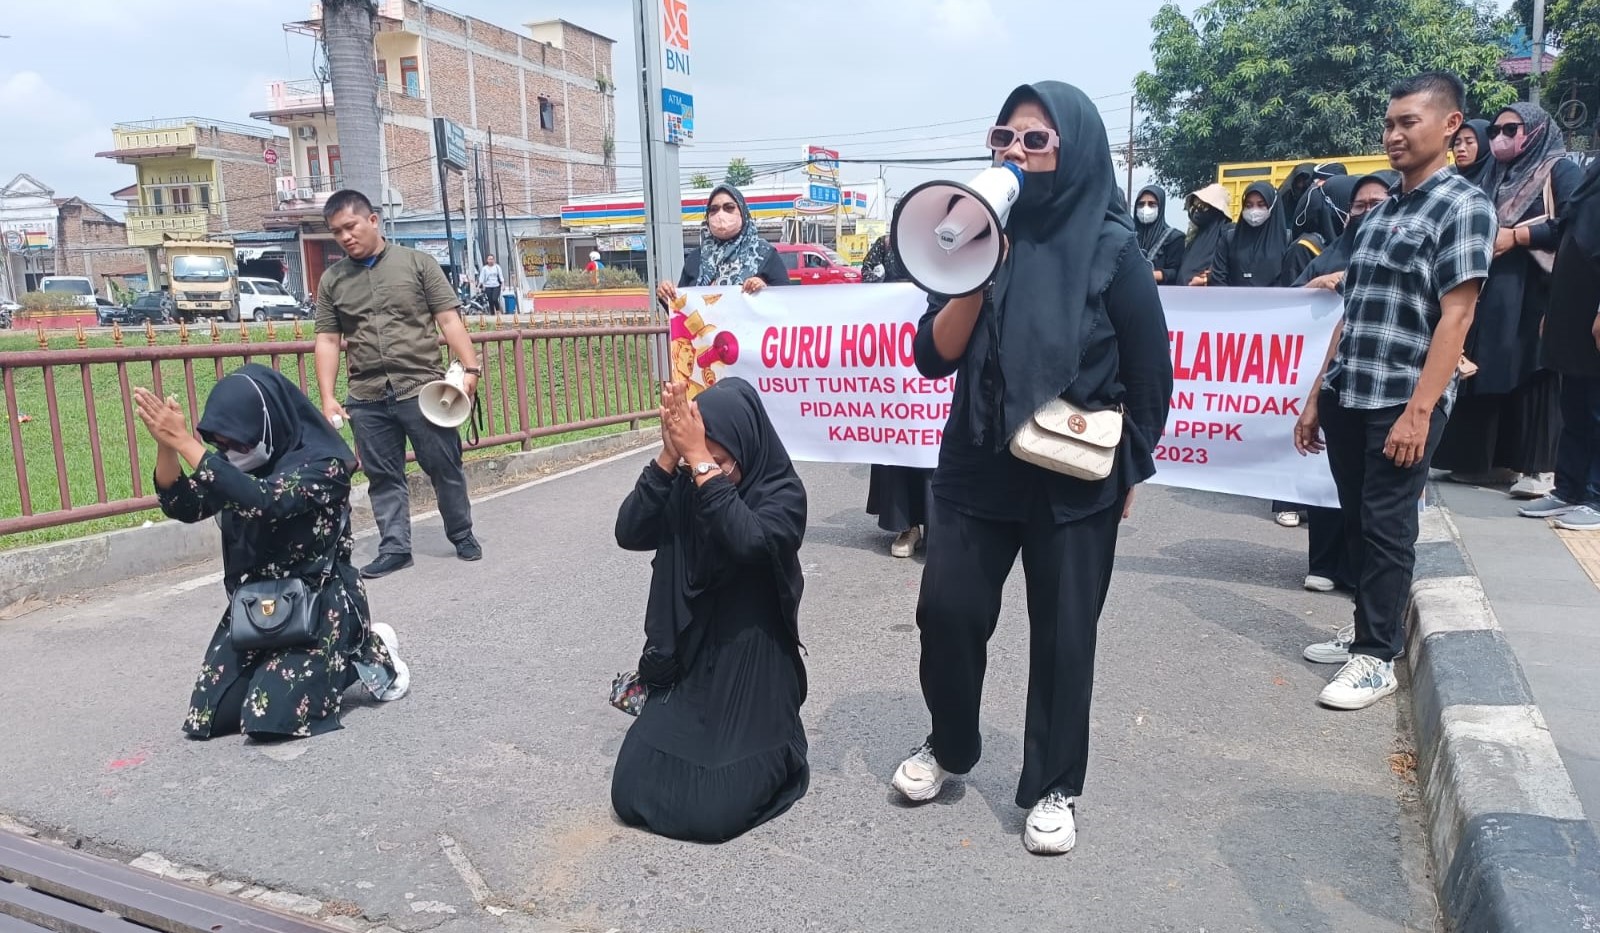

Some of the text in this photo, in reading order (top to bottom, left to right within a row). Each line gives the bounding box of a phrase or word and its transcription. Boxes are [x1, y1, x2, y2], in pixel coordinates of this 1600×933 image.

[666, 49, 690, 76] BNI
[668, 94, 682, 105] ATM
[761, 325, 833, 368] GURU
[758, 377, 810, 394] USUT
[815, 376, 896, 394] TUNTAS
[1203, 392, 1301, 416] TINDAK
[800, 401, 875, 418] PIDANA
[1174, 420, 1243, 442] PPPK
[1155, 445, 1208, 465] 2023
